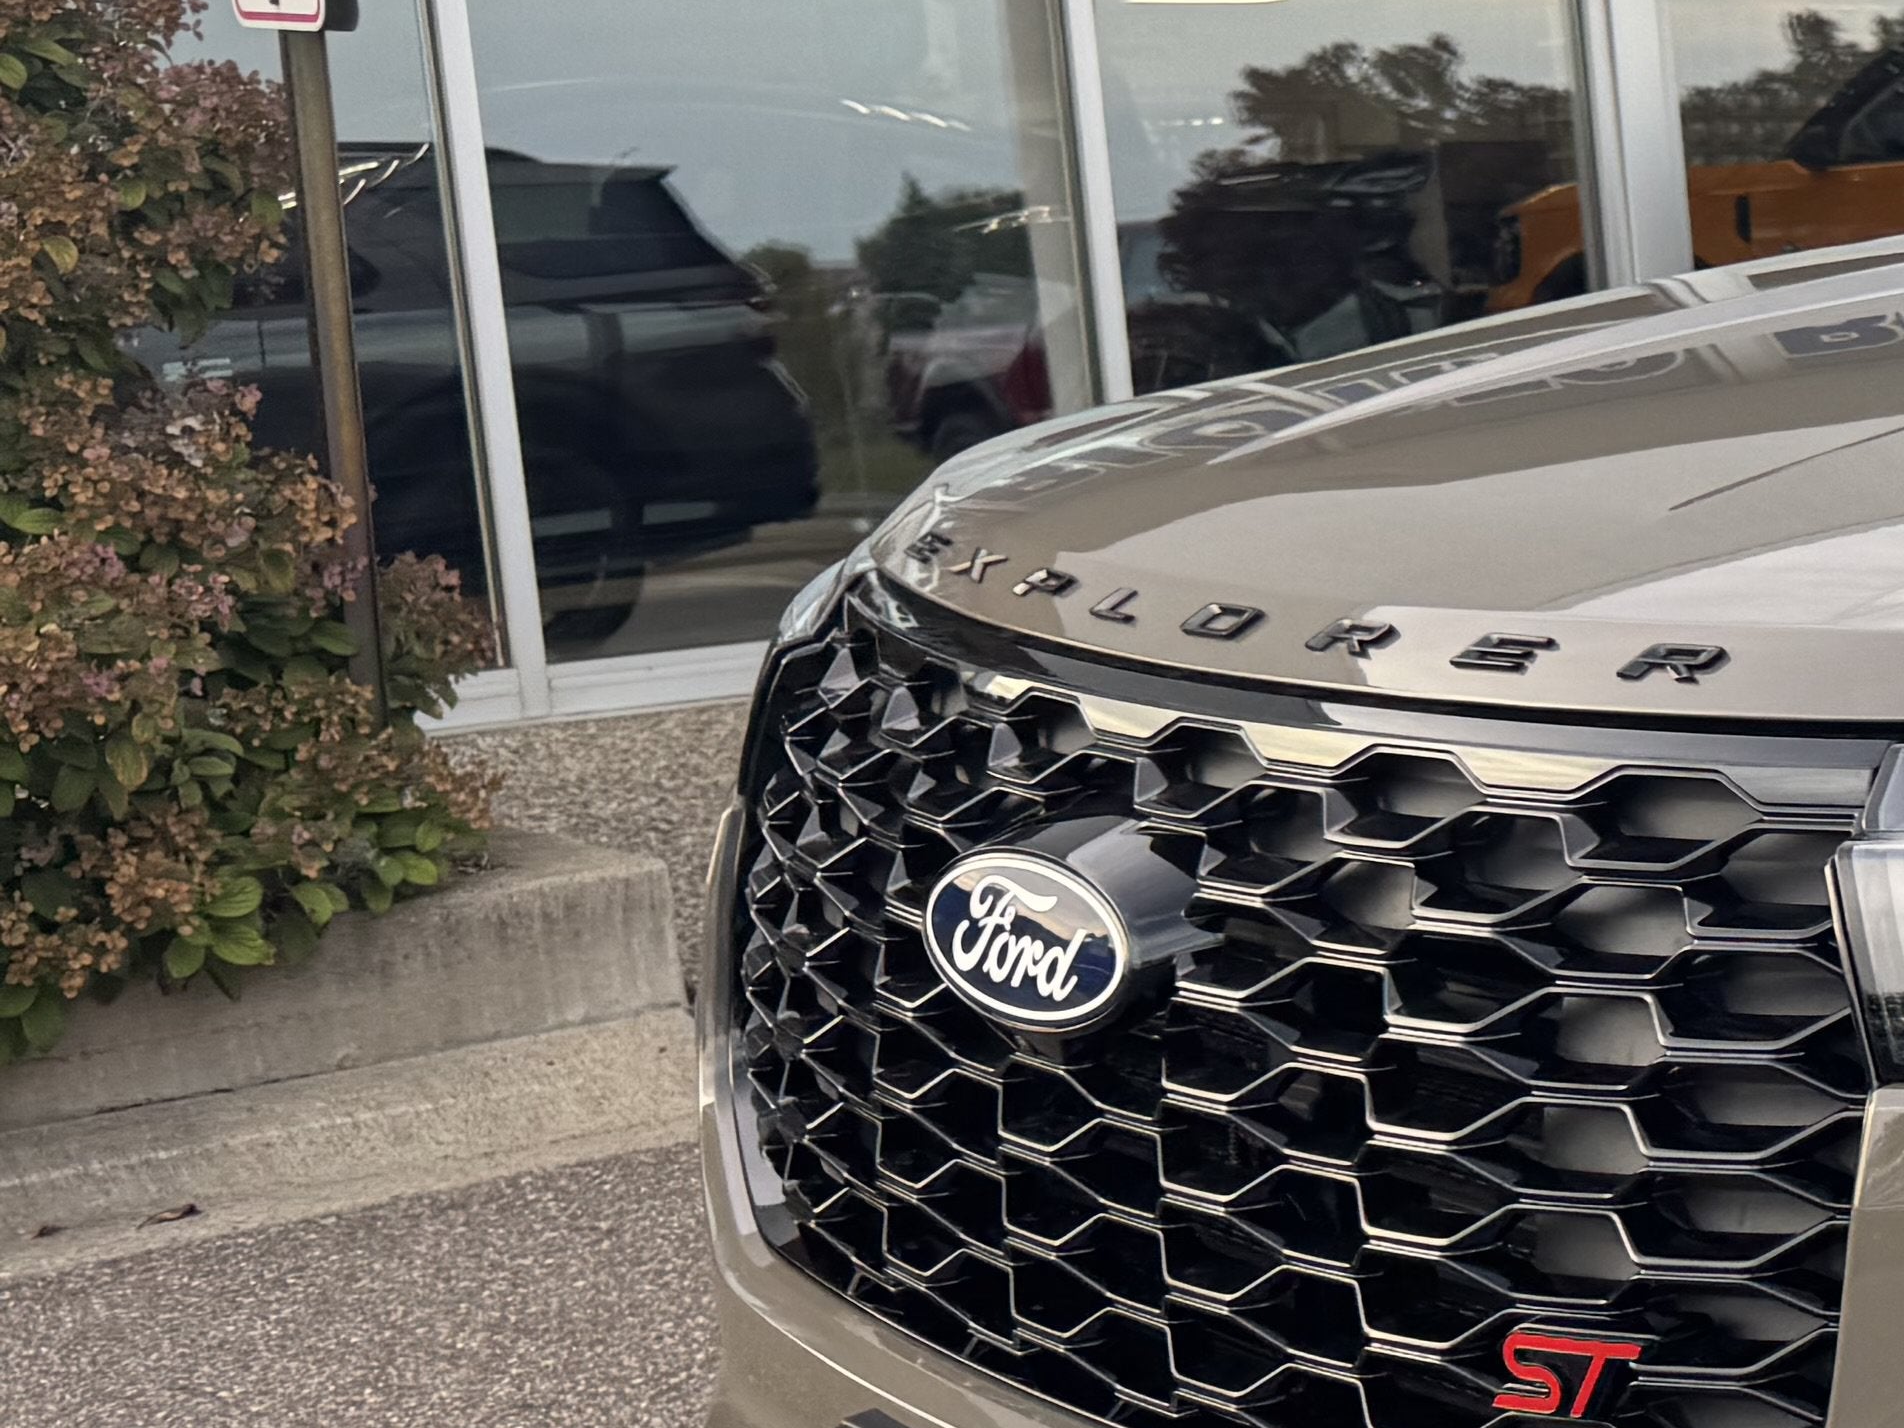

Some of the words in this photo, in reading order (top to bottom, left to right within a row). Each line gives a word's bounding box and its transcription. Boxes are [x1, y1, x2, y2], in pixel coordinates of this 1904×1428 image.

[904, 532, 1731, 684] EXPLORER
[952, 874, 1079, 1002] Ford
[1492, 1330, 1642, 1419] ST
